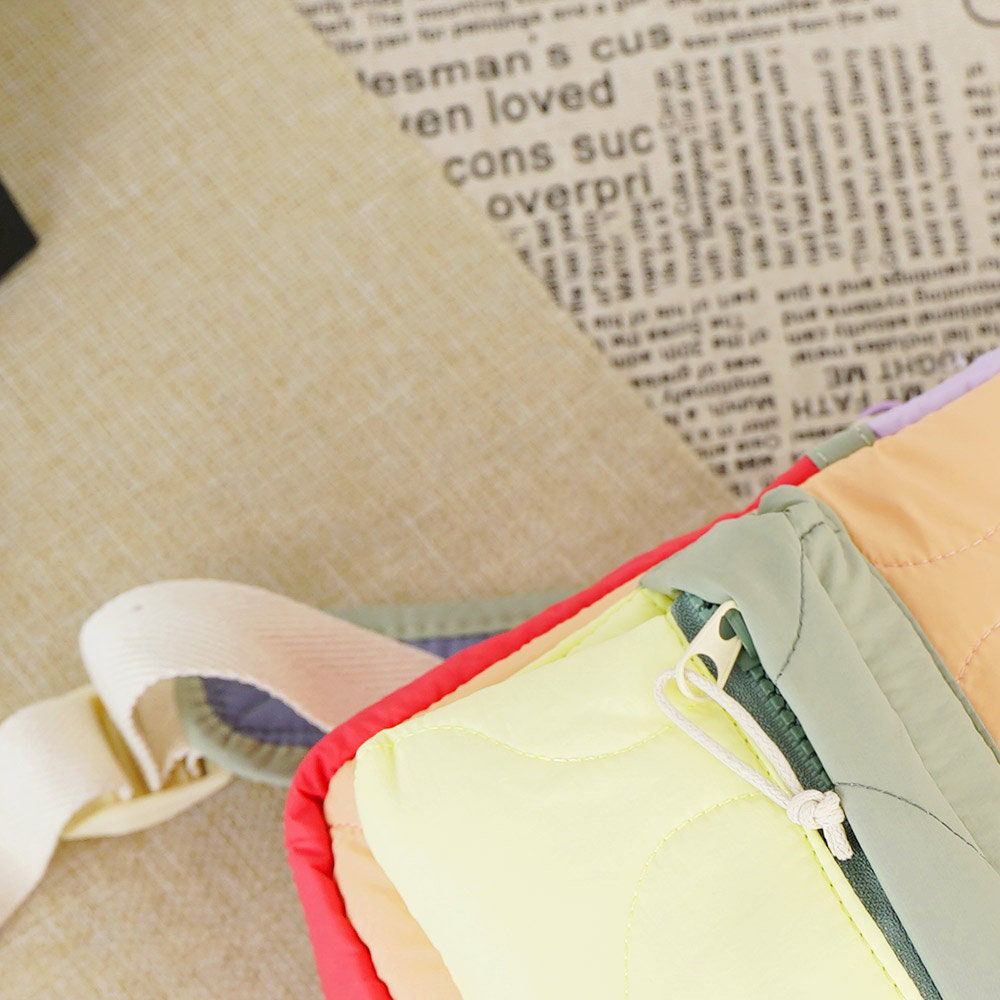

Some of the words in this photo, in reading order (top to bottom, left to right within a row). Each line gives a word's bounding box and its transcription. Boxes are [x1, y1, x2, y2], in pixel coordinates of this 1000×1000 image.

[485, 70, 616, 125] loved
[443, 141, 554, 188] cons
[572, 125, 655, 165] suc
[486, 163, 651, 221] overpri
